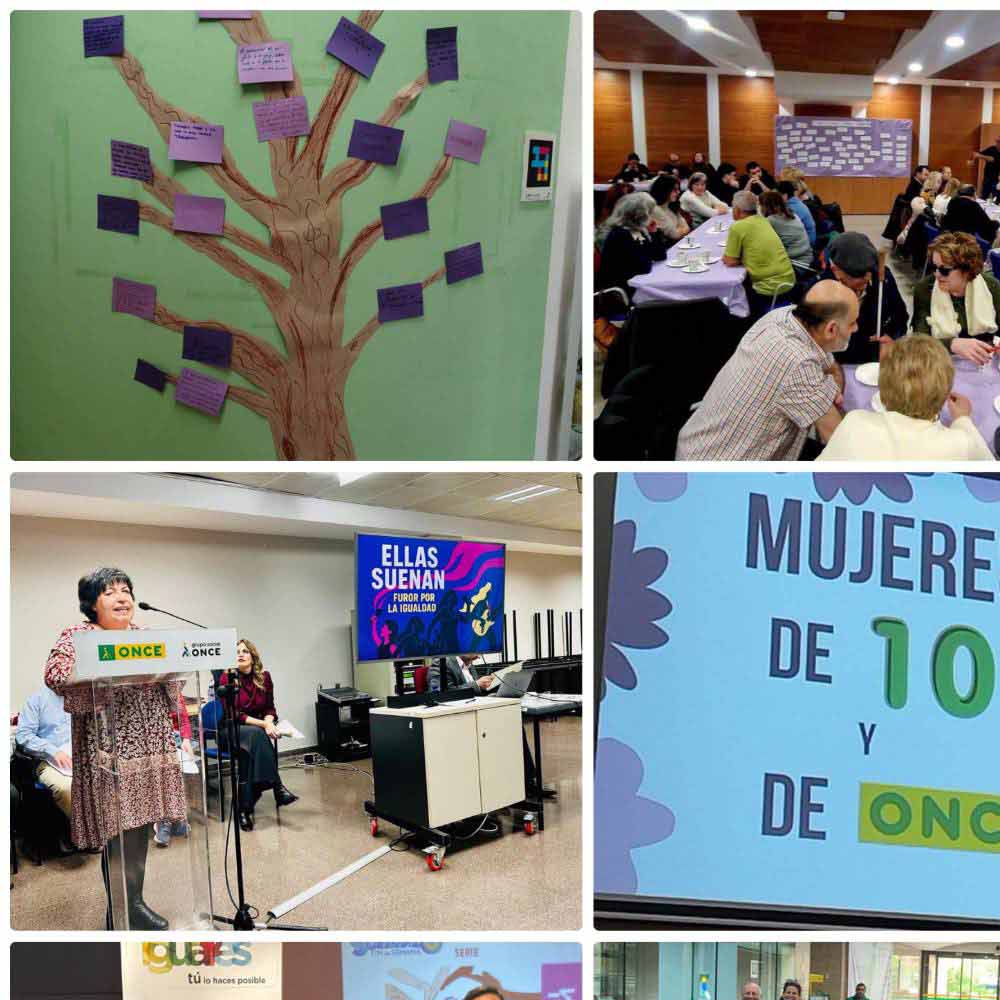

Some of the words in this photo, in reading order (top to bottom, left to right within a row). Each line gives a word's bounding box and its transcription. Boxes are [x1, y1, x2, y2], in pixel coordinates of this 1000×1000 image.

[382, 544, 438, 568] ELLAS
[371, 567, 445, 590] SUENAN
[393, 593, 418, 602] FUROR
[420, 593, 435, 602] POR
[388, 603, 397, 613] LA
[399, 603, 437, 613] IGUALDAD
[118, 646, 162, 657] ONCE
[192, 648, 221, 657] ONCE
[769, 618, 834, 683] DE
[870, 615, 996, 720] 10
[858, 722, 877, 756] Y
[761, 772, 828, 840] DE
[456, 947, 479, 957] SERIE
[188, 971, 201, 984] tú
[203, 976, 213, 985] lo
[213, 976, 236, 985] haces
[237, 976, 266, 986] posible
